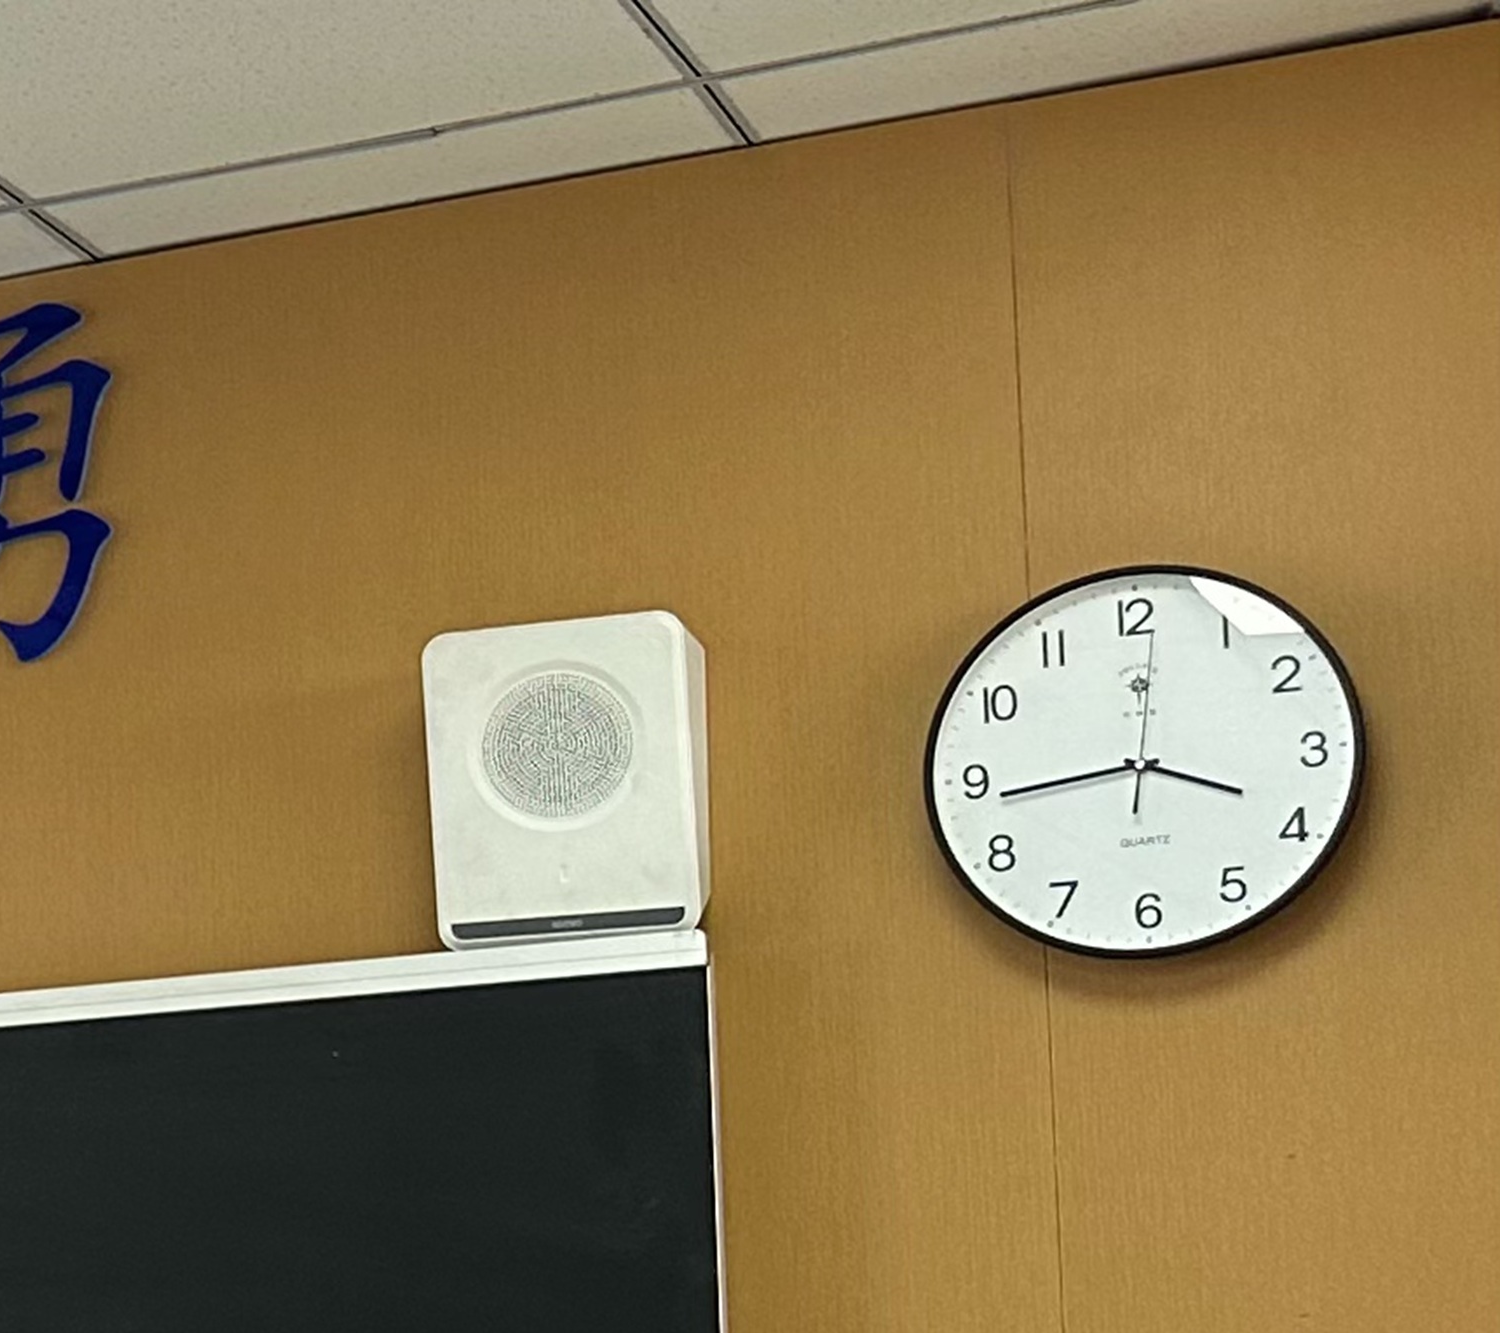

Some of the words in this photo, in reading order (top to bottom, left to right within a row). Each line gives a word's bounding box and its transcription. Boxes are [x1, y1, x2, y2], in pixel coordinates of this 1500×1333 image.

[1118, 598, 1155, 636] 12
[1222, 615, 1230, 648] 1
[1042, 630, 1065, 668] 11
[1270, 655, 1302, 694] 2
[983, 684, 1018, 723] 10
[1300, 731, 1328, 767] 3
[962, 764, 990, 800] 9
[1119, 834, 1171, 848] QUARTZ
[1279, 806, 1310, 843] 4
[987, 834, 1016, 872] 8
[1049, 880, 1078, 918] 7
[1219, 866, 1247, 903] 5
[1134, 893, 1163, 928] 6
